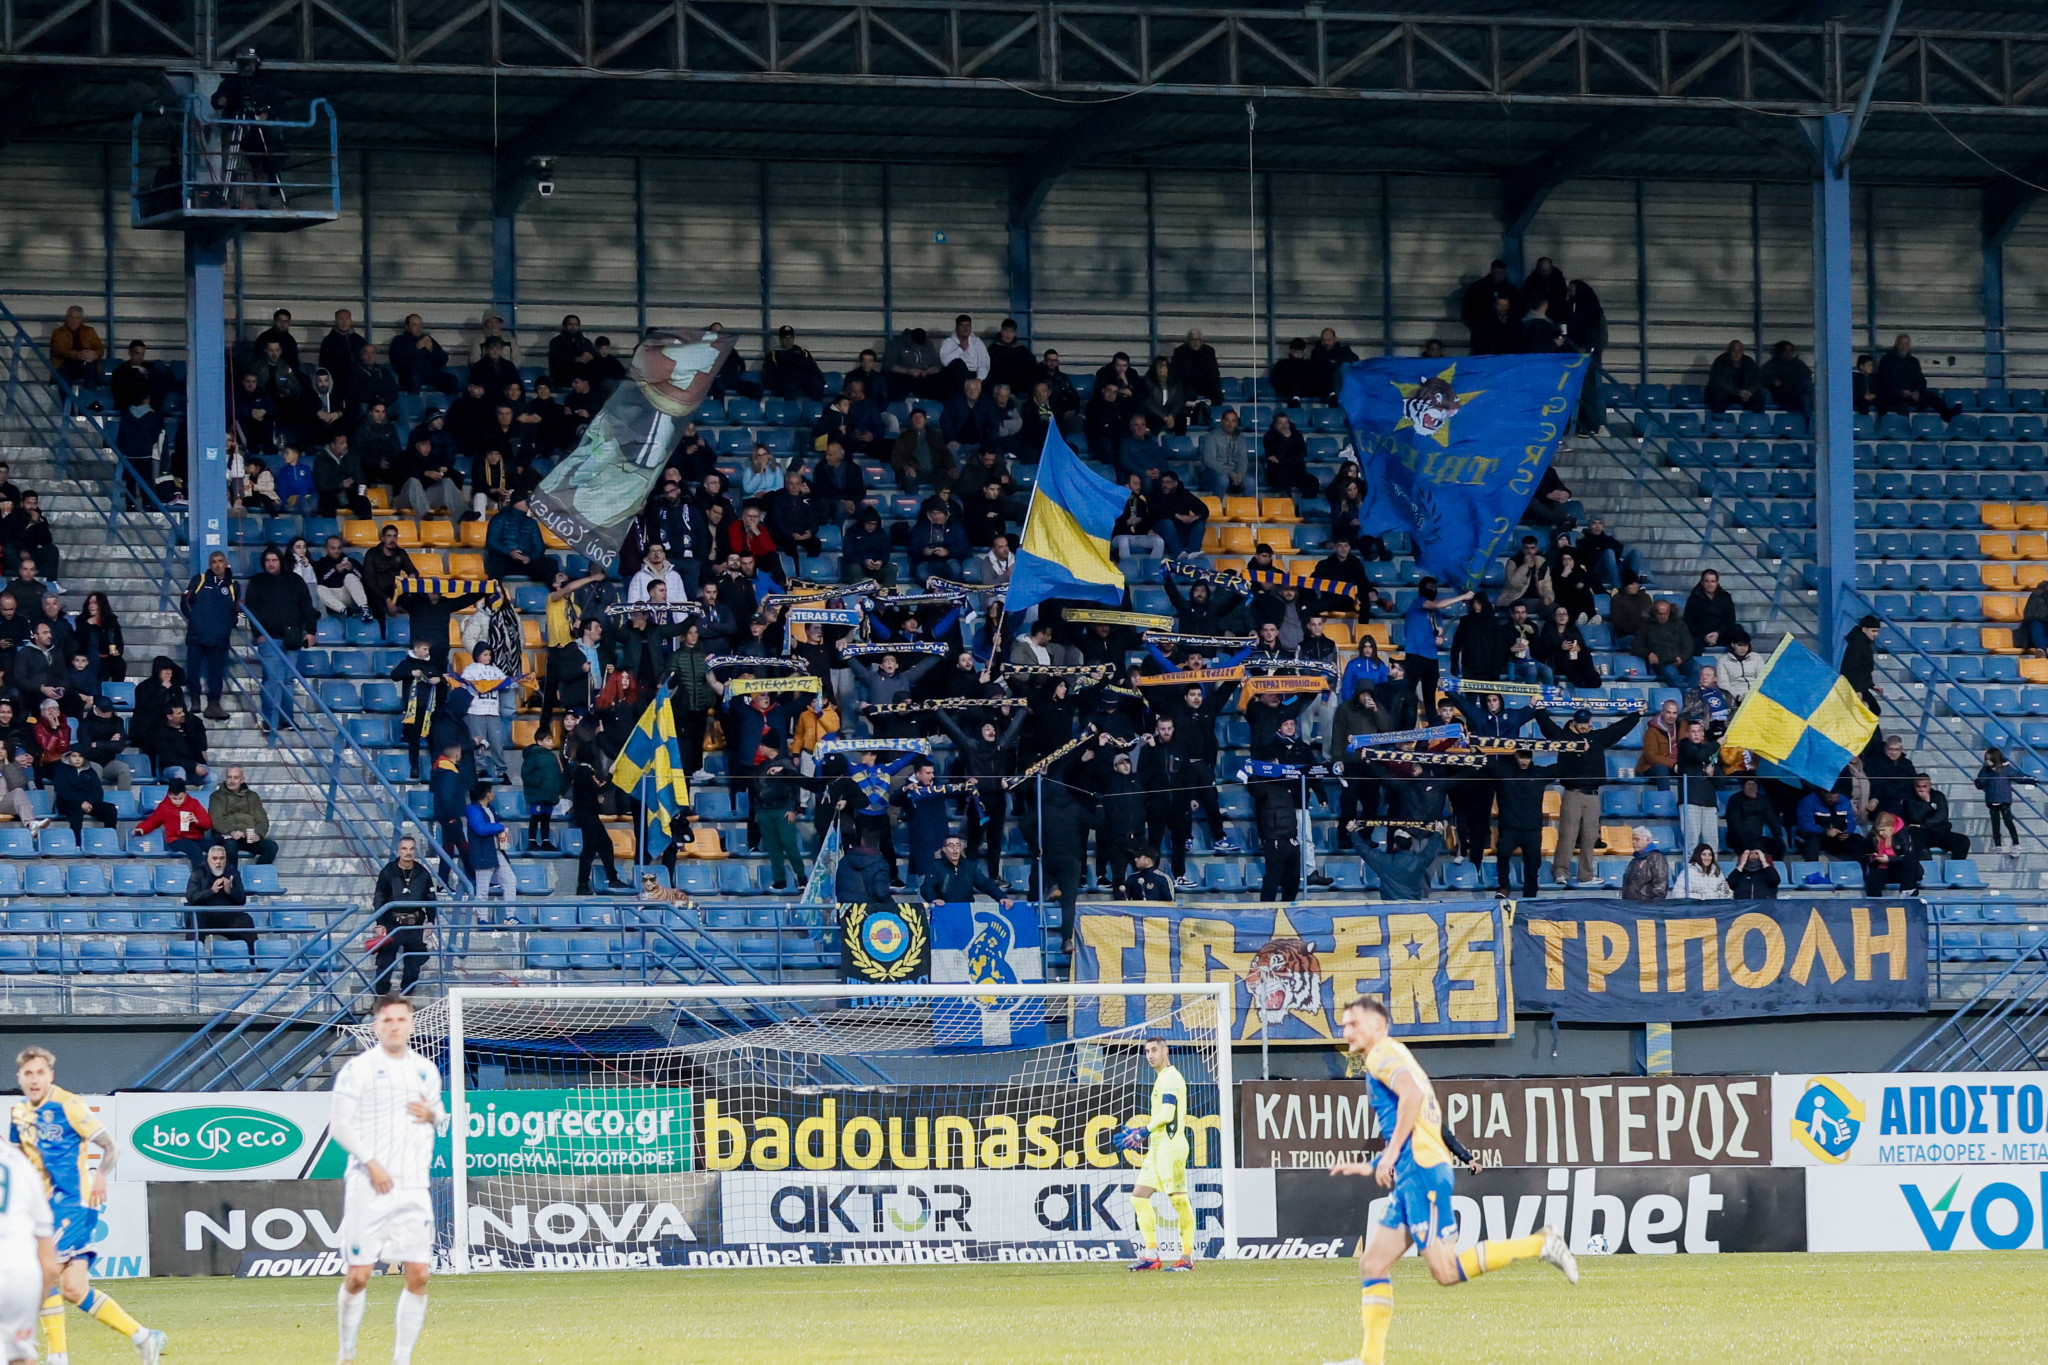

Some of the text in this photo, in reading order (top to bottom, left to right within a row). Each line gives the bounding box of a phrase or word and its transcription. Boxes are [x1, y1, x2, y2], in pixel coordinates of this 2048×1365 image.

[790, 612, 850, 622] STERAS F.C.
[744, 681, 793, 691] ASTERAS
[828, 739, 916, 751] ASTERAS FC
[1371, 725, 1447, 743] ASTERAS FC
[1527, 907, 1908, 993] ΤΡΙΠΟΛΗ
[1080, 908, 1497, 1028] TIGERS
[1256, 1081, 1759, 1163] ΚΛΗΜΡΙΑ ΠΙΤΕΡΟΣ
[1880, 1085, 2048, 1135] ΑΠΟΣΤΟ
[153, 1125, 190, 1148] bio
[237, 1131, 287, 1148] eco
[466, 1151, 558, 1170] ΟΤΟΠΟΥΛΑ
[573, 1150, 676, 1168] ΖΩΟΤΡΟΦΕΣ
[1879, 1143, 1986, 1163] ΜΕΤΑΦΟΡΕΣ
[1899, 1171, 2048, 1250] VO
[185, 1207, 345, 1251] NOV
[468, 1202, 698, 1246] NOVA
[533, 1245, 662, 1270] novibet
[688, 1243, 815, 1268] novibet
[841, 1241, 967, 1265] novibet
[998, 1241, 1122, 1263] novibet
[1216, 1238, 1345, 1259] ovibet
[247, 1251, 350, 1278] novib
